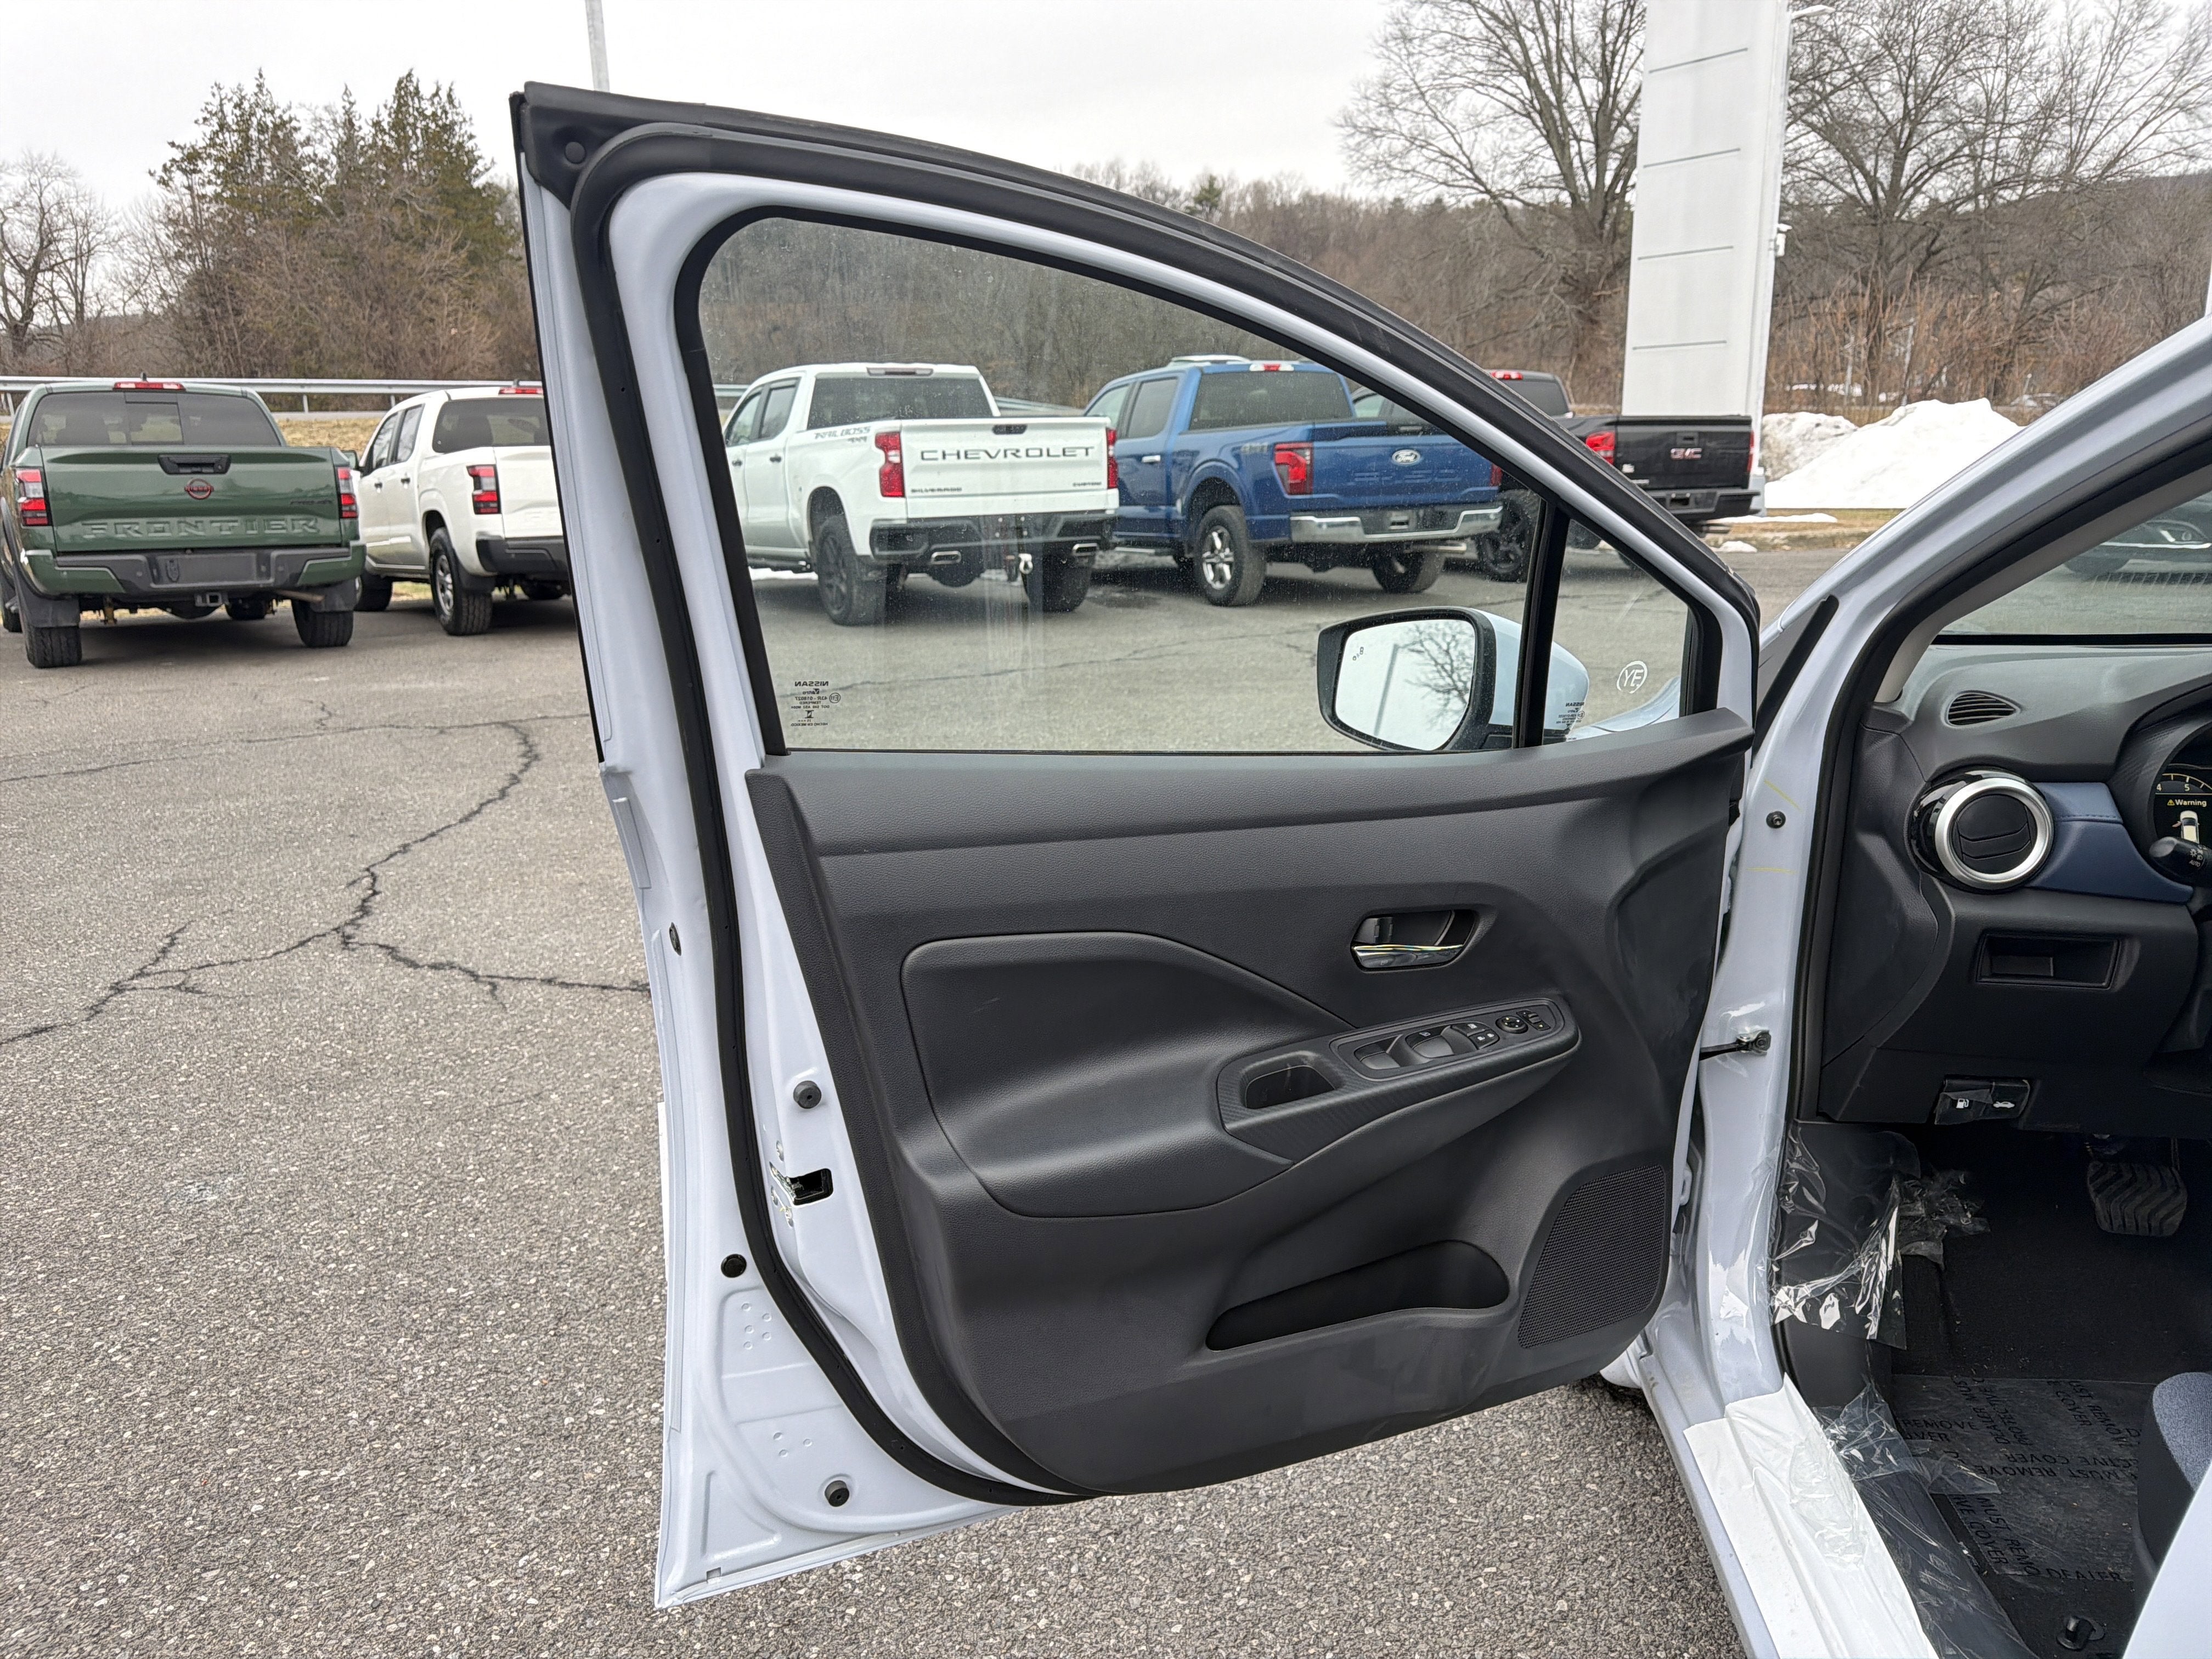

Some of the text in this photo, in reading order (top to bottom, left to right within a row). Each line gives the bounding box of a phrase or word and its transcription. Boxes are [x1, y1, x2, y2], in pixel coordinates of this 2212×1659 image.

[921, 446, 1094, 461] CHEVROLET
[1397, 452, 1417, 462] Ford
[1671, 448, 1702, 460] GMC
[82, 517, 320, 539] FRONTIER
[2184, 783, 2190, 792] 5
[2175, 799, 2207, 807] Warning
[1951, 1375, 1978, 1401] MUS
[2056, 1391, 2092, 1426] COVER
[1901, 1419, 1979, 1430] REMOVE
[1972, 1407, 2011, 1444] DEALER
[2006, 1454, 2070, 1465] COVER
[1975, 1465, 2057, 1477] REMOVE
[2068, 1468, 2121, 1480] MUST
[1976, 1497, 2011, 1531] MUST
[1969, 1521, 2009, 1564] COVER
